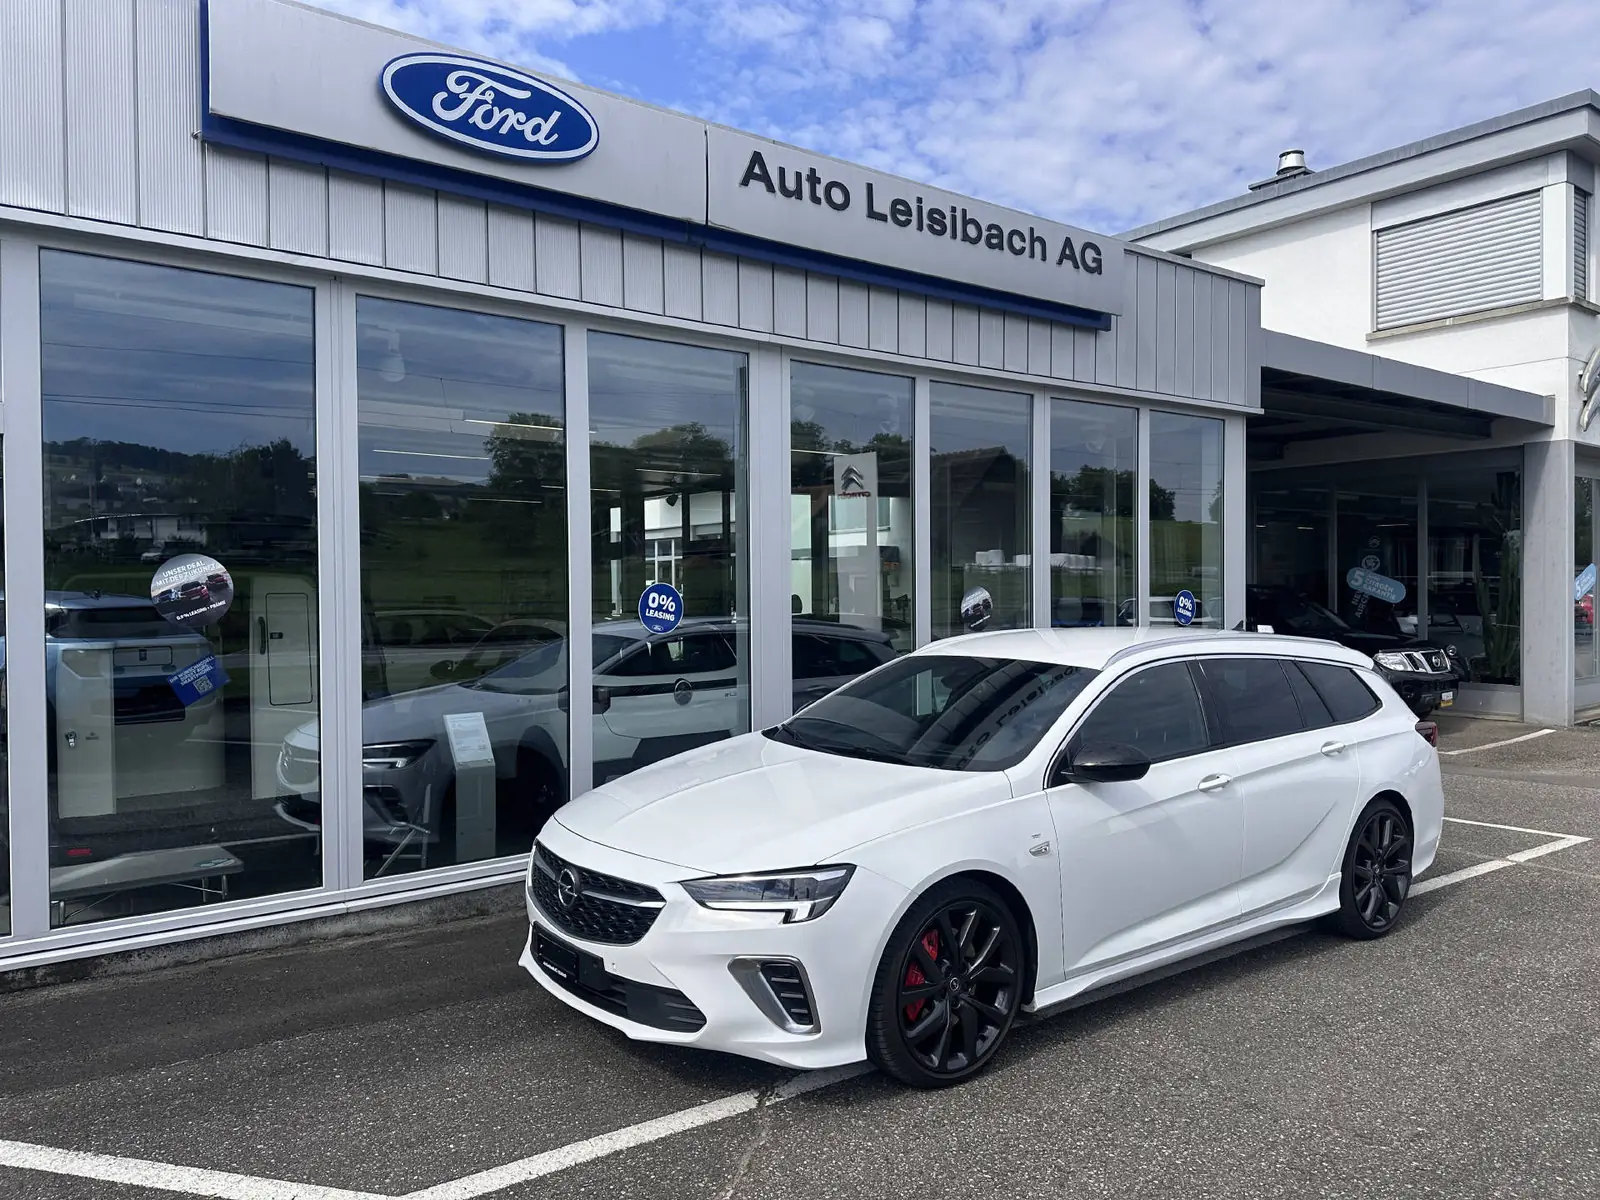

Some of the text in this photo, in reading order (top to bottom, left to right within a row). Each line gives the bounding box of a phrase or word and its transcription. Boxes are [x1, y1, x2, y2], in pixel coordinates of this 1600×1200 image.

[431, 69, 561, 146] Ford
[739, 150, 1103, 275] Auto Leisibach AG
[162, 560, 206, 577] UNSER DEAL
[156, 577, 169, 587] MIT
[1351, 570, 1364, 585] 5
[649, 592, 676, 612] 0%
[1179, 596, 1192, 611] 0%
[645, 607, 675, 621] LEASING
